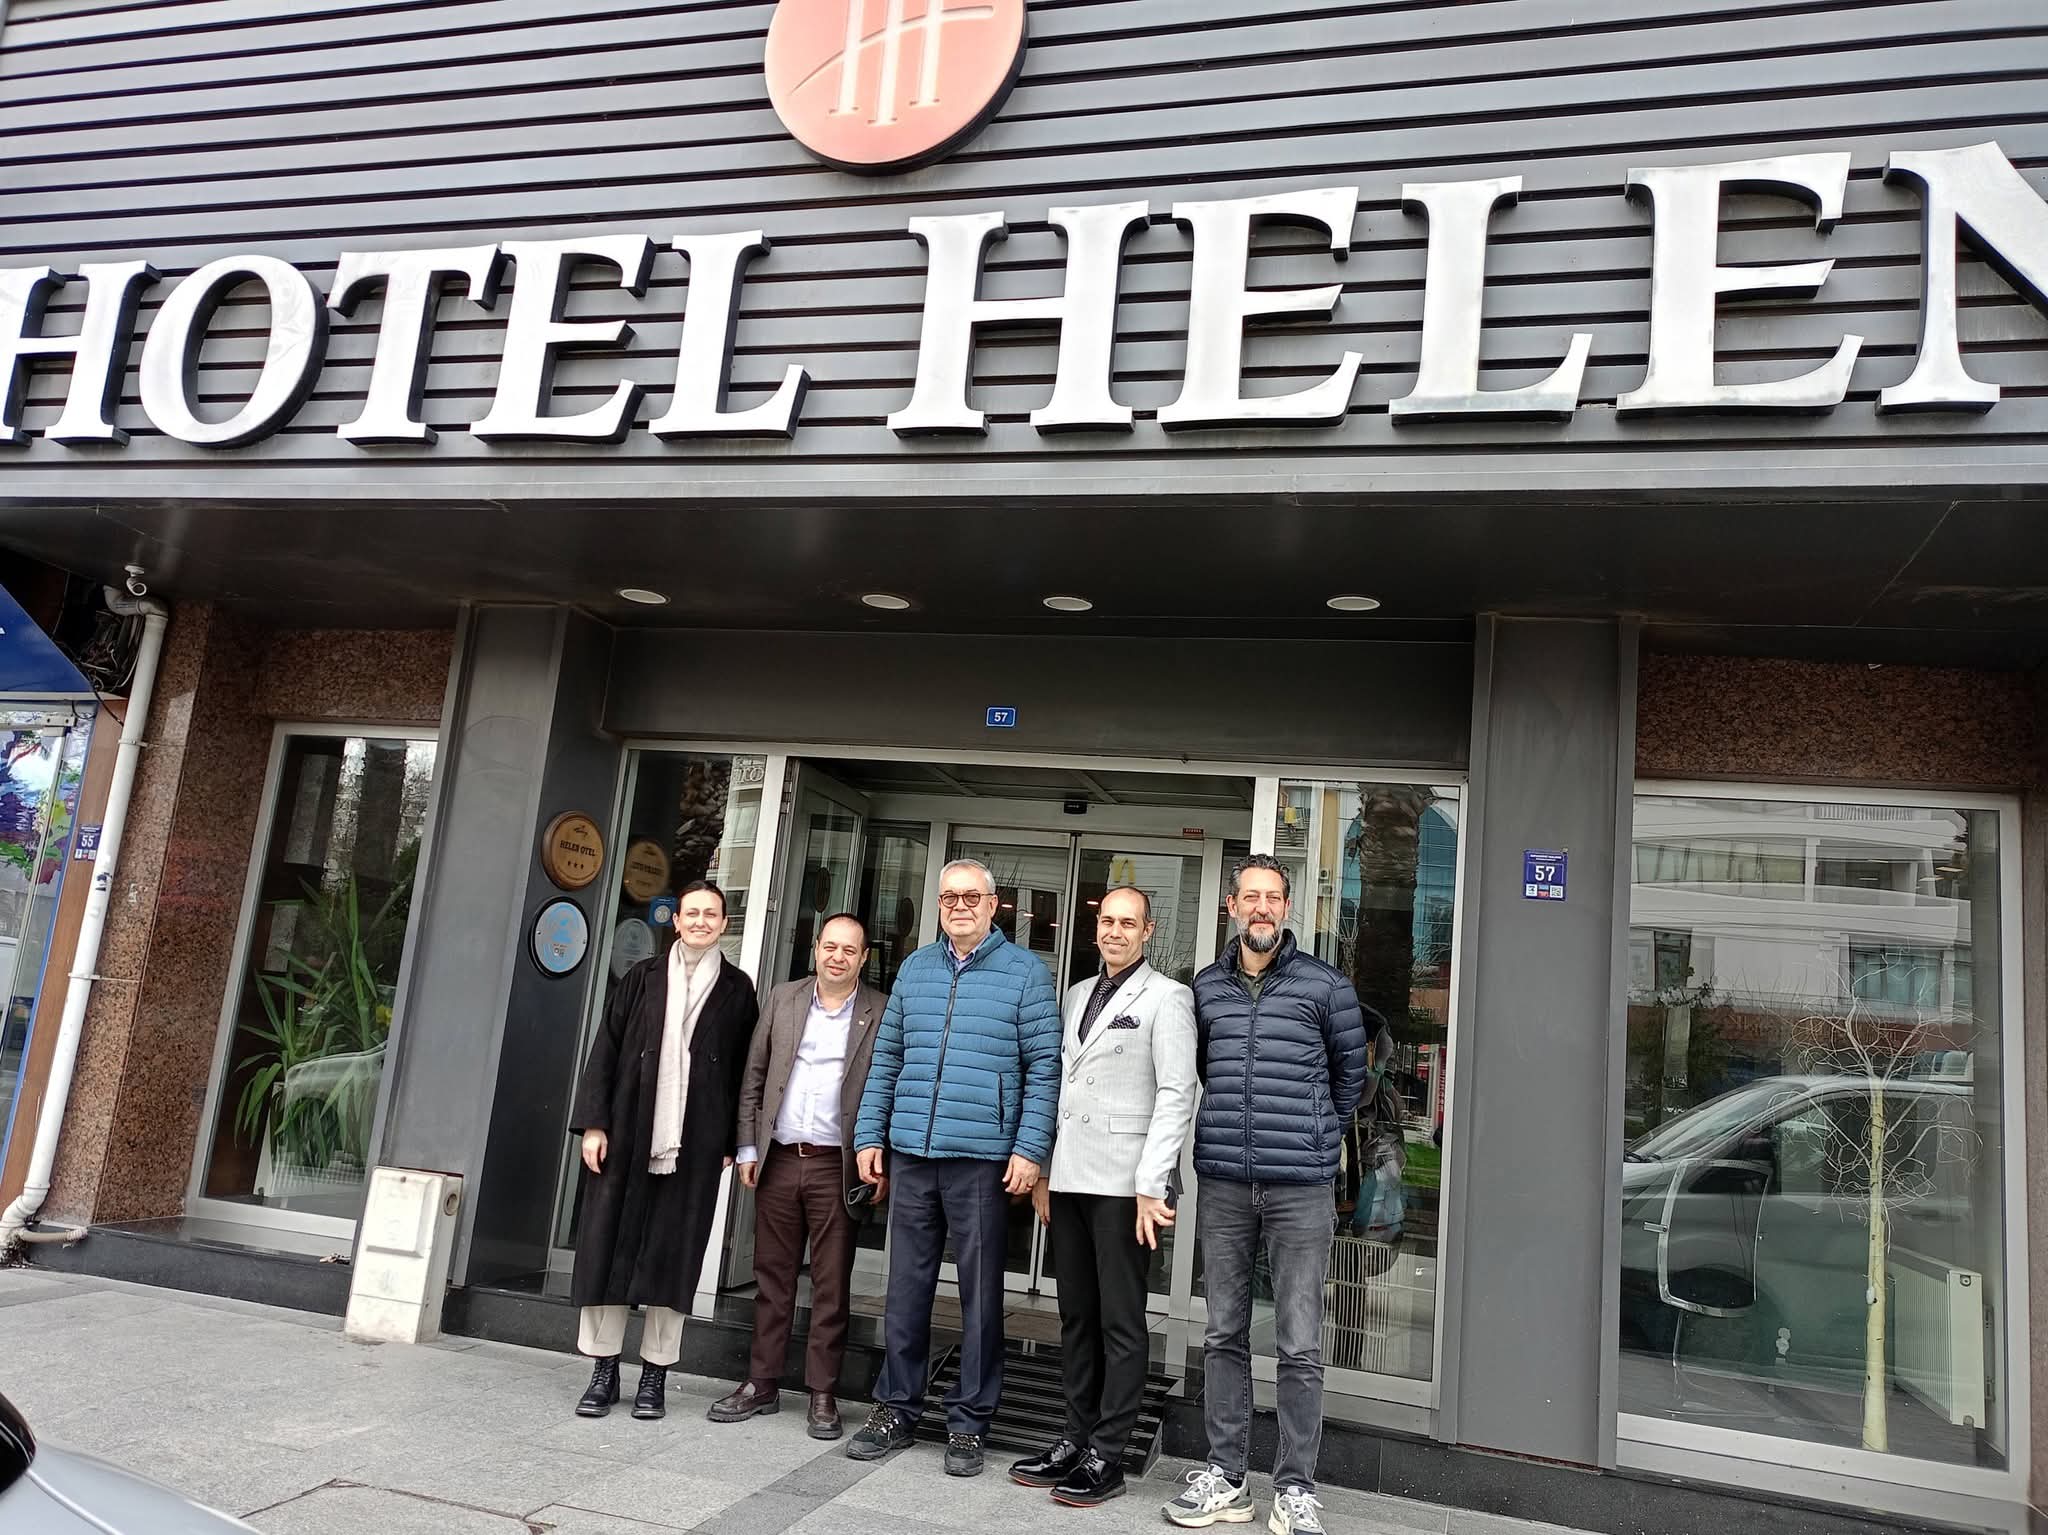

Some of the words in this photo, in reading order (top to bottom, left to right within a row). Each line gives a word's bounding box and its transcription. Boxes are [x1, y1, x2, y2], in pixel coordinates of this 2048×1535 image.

[0, 231, 811, 446] HOTEL
[994, 711, 1009, 723] 57
[81, 834, 95, 848] 55
[580, 845, 596, 857] OTEL
[1534, 864, 1556, 882] 57
